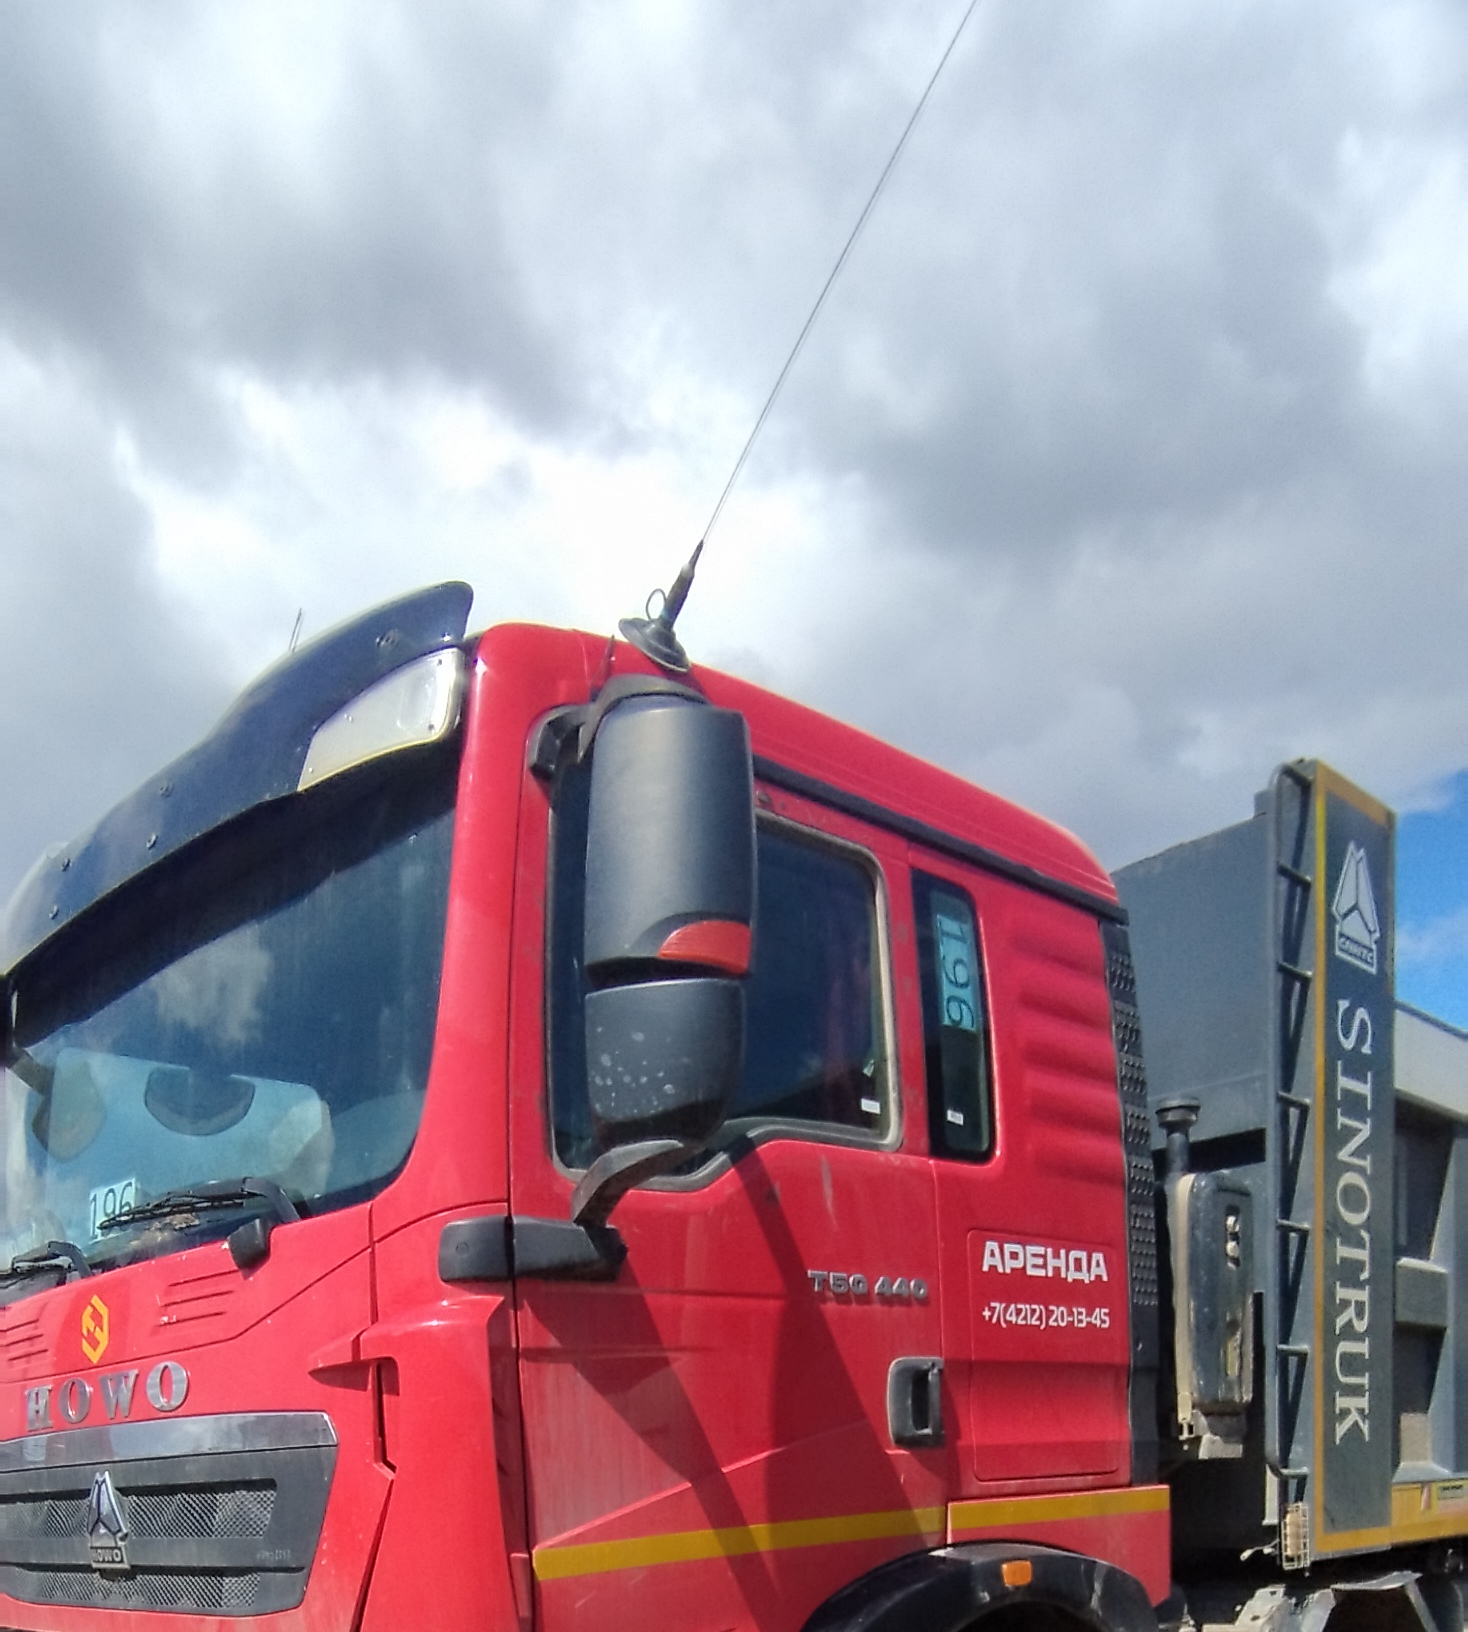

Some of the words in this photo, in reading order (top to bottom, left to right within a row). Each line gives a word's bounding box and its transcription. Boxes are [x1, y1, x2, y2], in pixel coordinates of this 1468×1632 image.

[938, 919, 975, 1030] 196
[1335, 999, 1373, 1445] SINOTRUK
[807, 1269, 868, 1295] T5G
[874, 1276, 928, 1299] 440
[982, 1240, 1109, 1283] АРЕНДА
[1049, 1306, 1110, 1329] 20-13-45
[24, 1361, 190, 1432] HOWO
